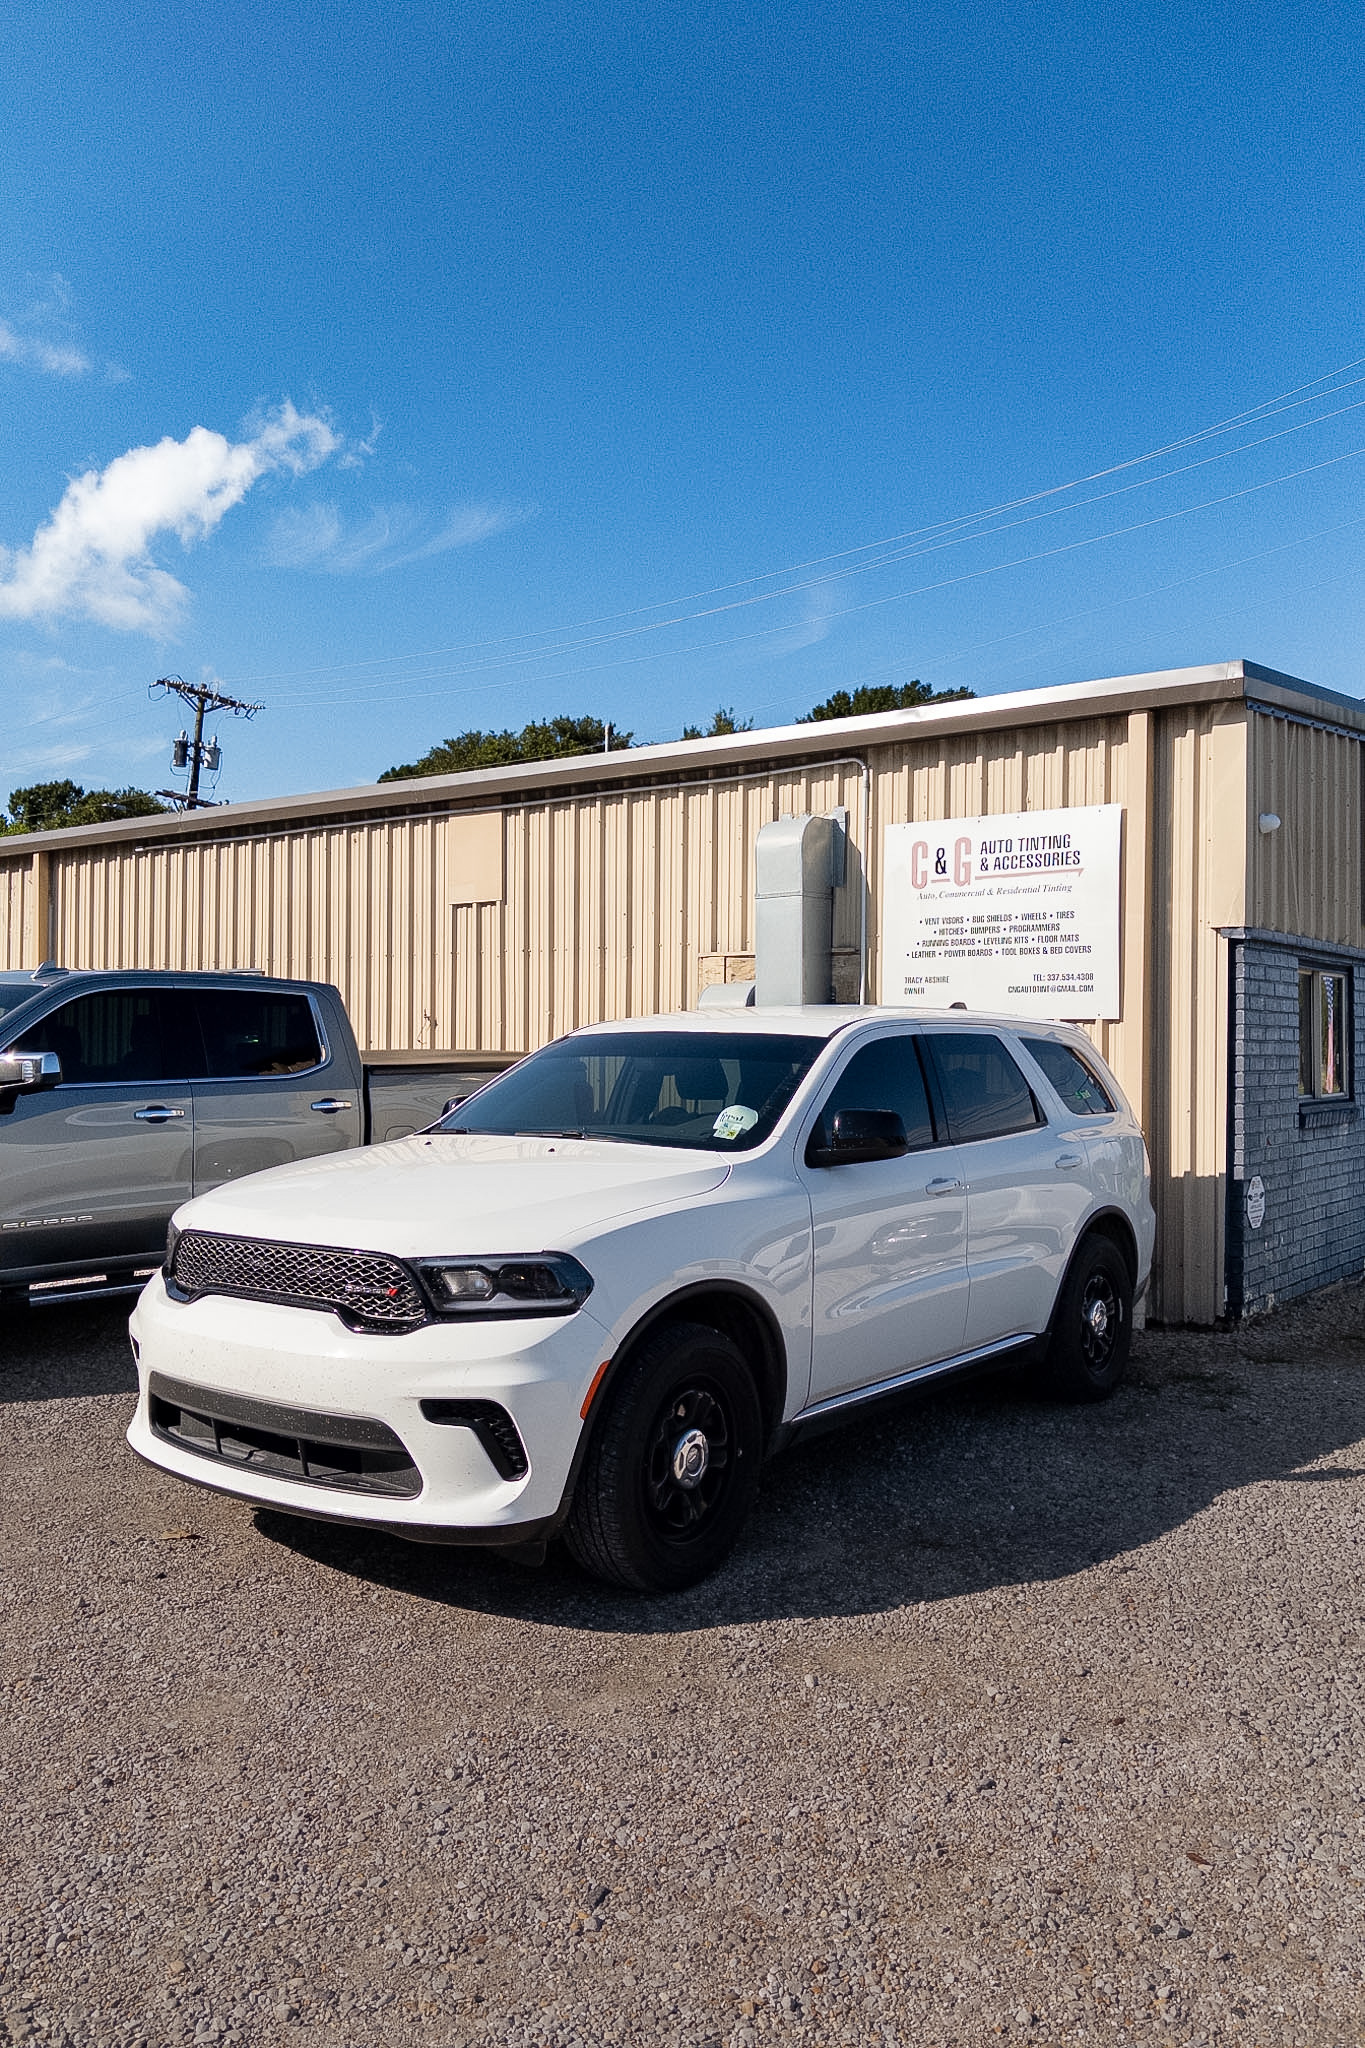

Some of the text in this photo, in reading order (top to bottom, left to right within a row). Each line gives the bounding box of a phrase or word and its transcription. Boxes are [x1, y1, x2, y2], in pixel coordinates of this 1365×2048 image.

[980, 834, 1072, 855] AUTO TINTING
[911, 837, 972, 889] C & G
[980, 850, 1081, 871] & ACCESSORIES
[917, 883, 1073, 901] Auto, Commercial & Residential Tinting
[924, 910, 1075, 925] VENT VISORS BUG SHIELDS WHEELS TIRES
[938, 923, 1060, 936] HITCHES BUMPERS PROGRAMMERS
[921, 934, 1080, 947] RUNNING BOARDS LEVELING KITS FLOOR MATS
[911, 945, 1092, 958] LEATHER POWER BOARDS TOOL BOXES & BED COVERS
[904, 976, 923, 984] TRACY
[1033, 973, 1046, 982] TEL:
[904, 987, 925, 995] OWNER
